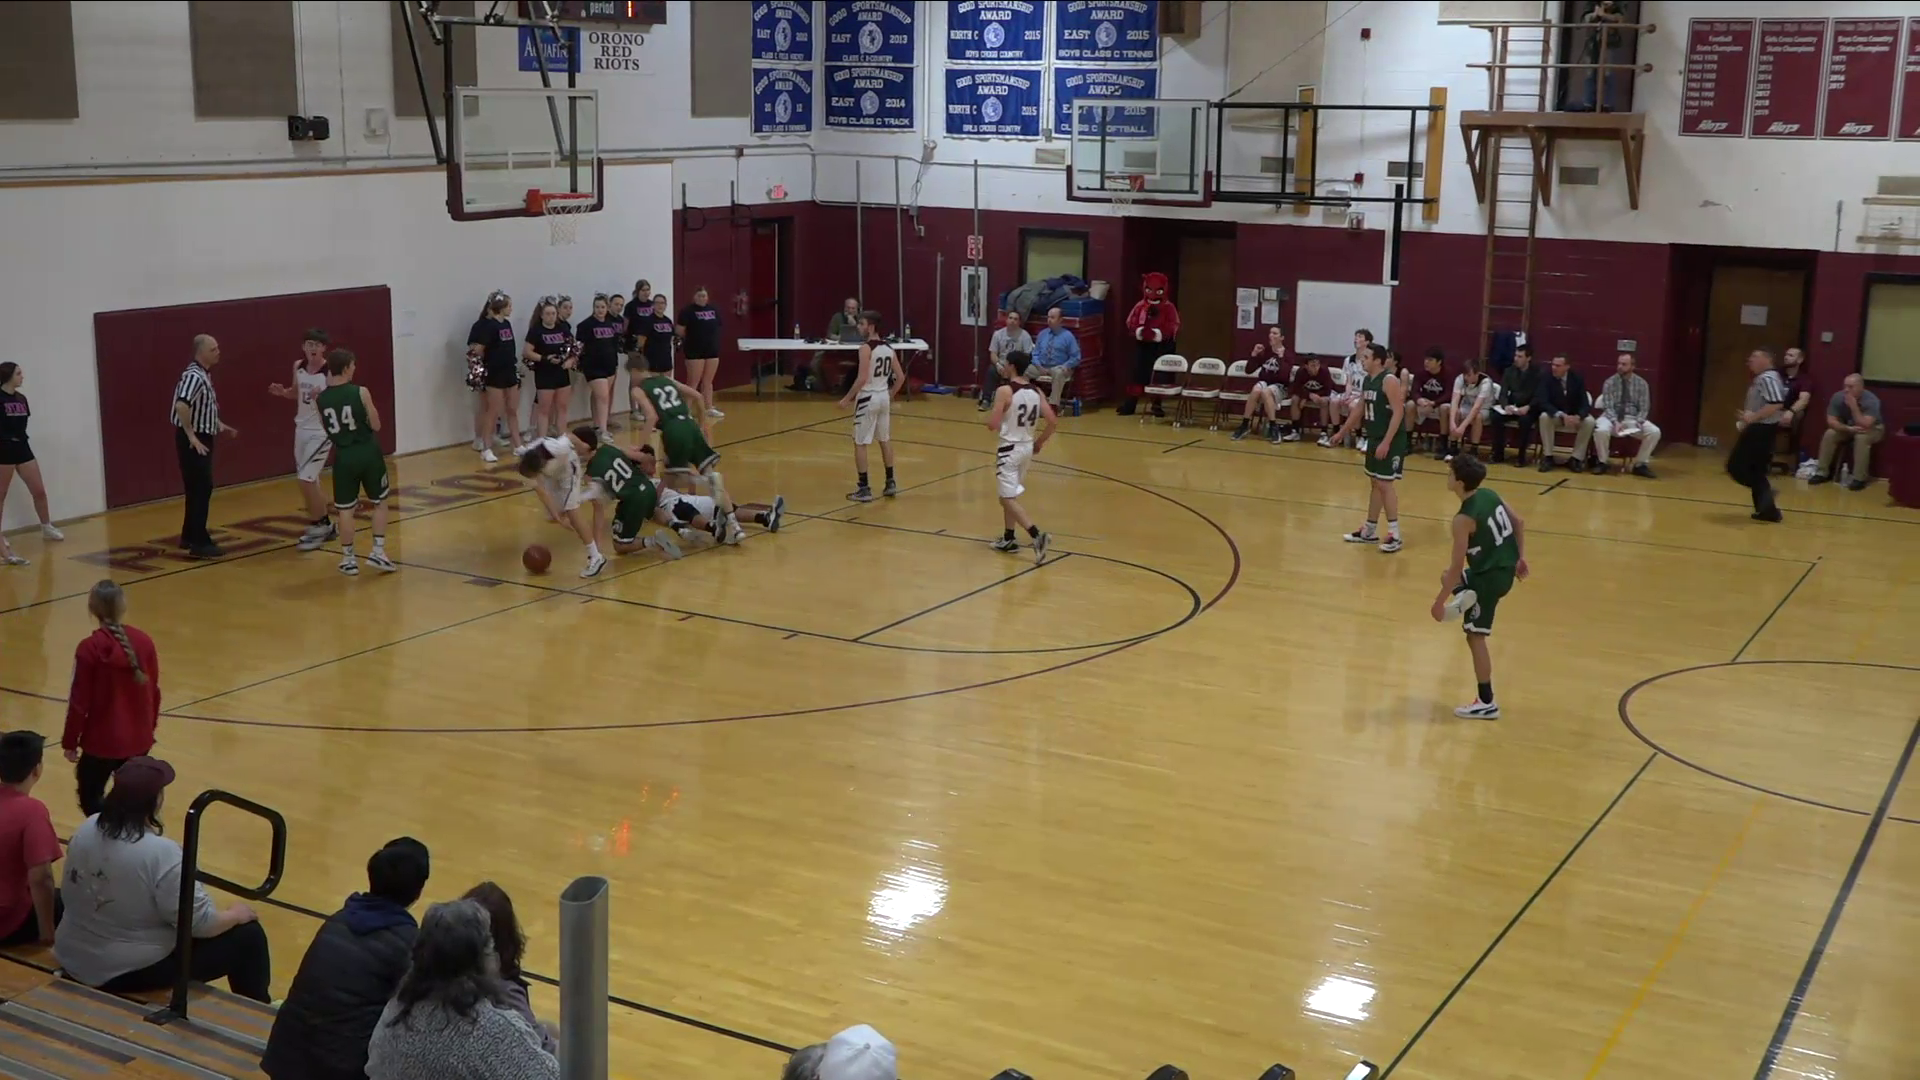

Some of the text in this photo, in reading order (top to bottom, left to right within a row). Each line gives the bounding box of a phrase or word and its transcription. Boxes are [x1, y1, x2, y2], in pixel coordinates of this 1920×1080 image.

[589, 1, 614, 16] period
[958, 1, 1034, 14] GOOD SPORTSMANSHIP
[1068, 1, 1148, 14] GOOD SPORTSMANSHIP
[829, 2, 911, 26] GOOD SPORTSMANSHIP
[858, 12, 882, 21] AWARD
[980, 11, 1012, 20] AWARD
[1090, 10, 1124, 20] AWARD
[588, 32, 644, 46] ORONO
[757, 29, 770, 38] EAST
[831, 34, 908, 44] EAST 2013
[950, 30, 1040, 40] NORTH C 2015
[1064, 31, 1149, 40] EAST 2015
[600, 45, 632, 58] RED
[1114, 50, 1120, 58] C
[1122, 50, 1153, 58] TENNIS
[1782, 45, 1815, 53] Champions
[1856, 45, 1890, 53] Champions
[594, 58, 640, 70] RIOTS
[834, 68, 904, 83] GOOD SPORTSMANSHIP
[854, 79, 884, 88] AWARD
[956, 74, 1030, 89] GOOD SPORTSMANSHIP
[1066, 74, 1145, 89] GOOD SPORTSMANSHIP
[977, 86, 1008, 94] AWARD
[831, 97, 906, 108] EAST 2014
[948, 105, 1038, 115] NORTH C 2015
[1124, 106, 1146, 115] 2015
[828, 116, 847, 124] BOYS
[848, 117, 874, 125] CLASS
[884, 118, 910, 126] TRACK
[1103, 125, 1147, 133] OFTBALL
[874, 356, 891, 378] 20
[653, 385, 681, 410] 22
[323, 405, 357, 434] 34
[1017, 403, 1037, 427] 24
[604, 457, 632, 492] 20
[1487, 504, 1513, 546] 10
